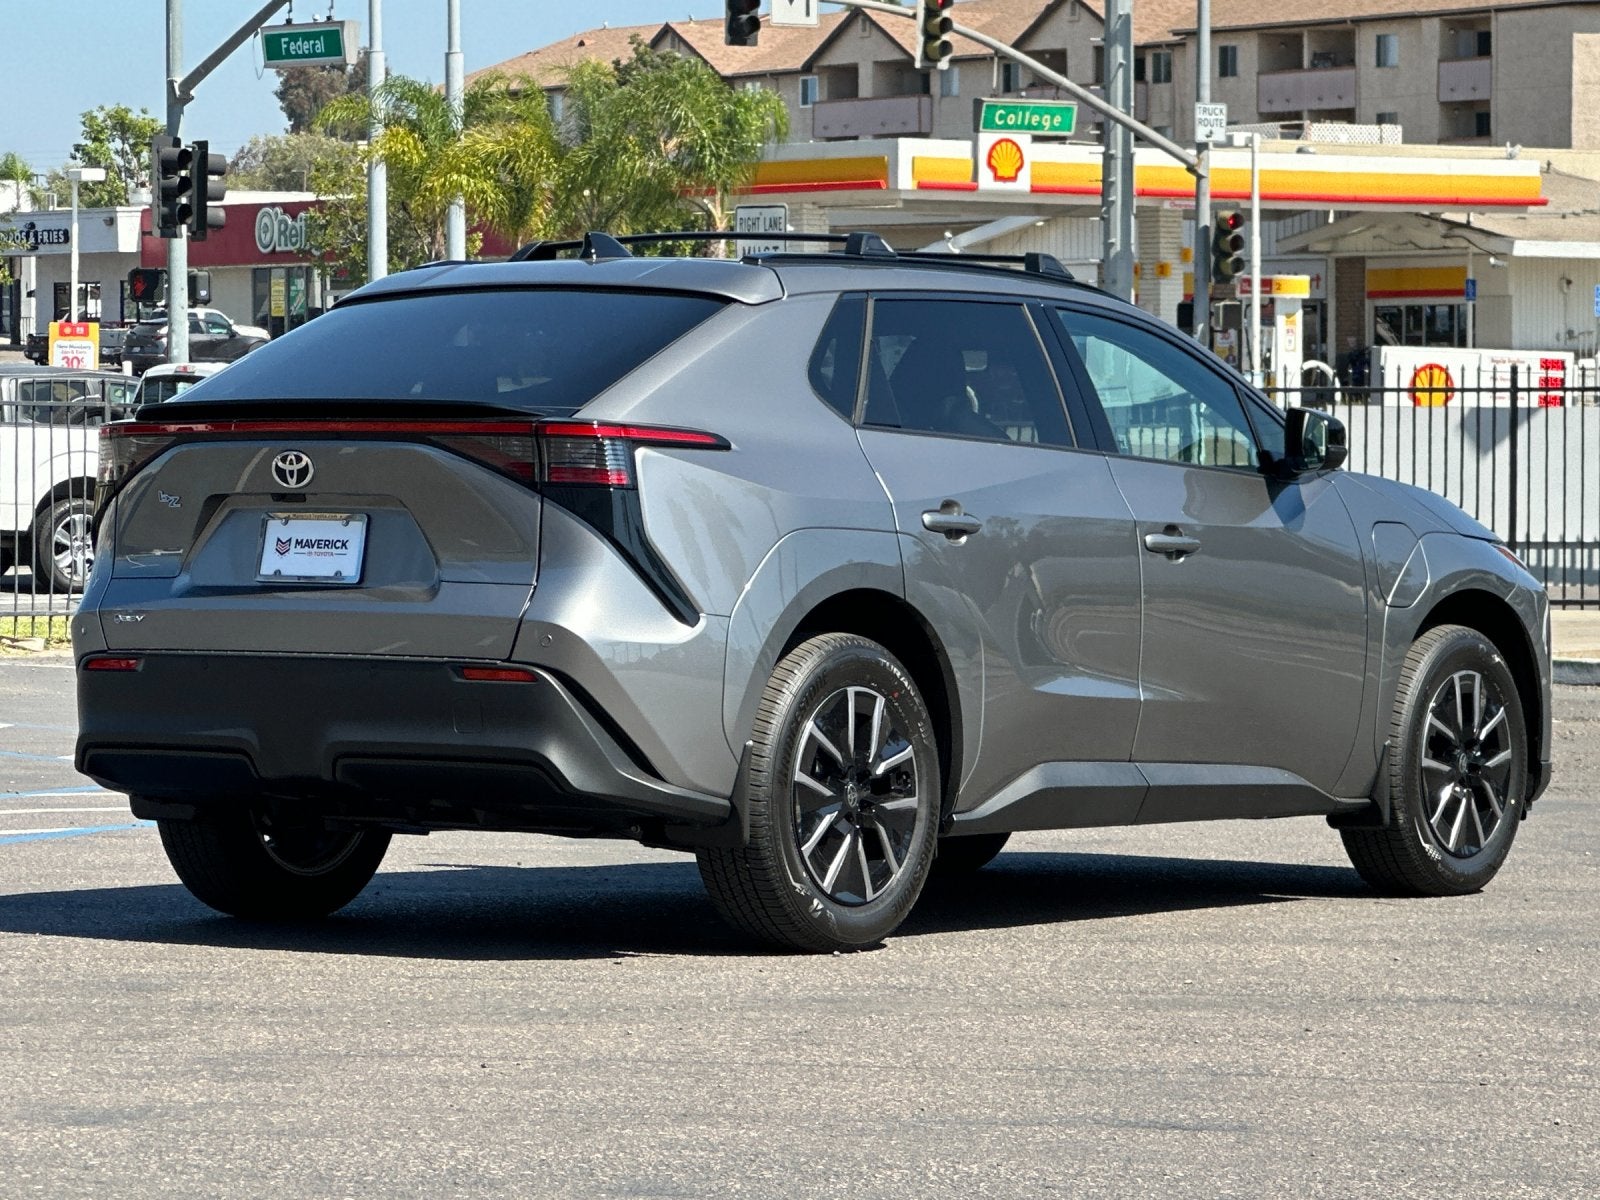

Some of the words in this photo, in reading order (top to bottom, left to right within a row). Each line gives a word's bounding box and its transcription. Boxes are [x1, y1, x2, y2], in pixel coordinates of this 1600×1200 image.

[281, 35, 325, 55] Federal
[1198, 107, 1225, 116] TRUCK
[994, 109, 1062, 131] College
[1198, 118, 1225, 127] ROUTE
[739, 216, 760, 232] RIGHT
[764, 216, 782, 232] LANE
[38, 230, 65, 243] FRIES
[294, 538, 349, 550] MAVERICK
